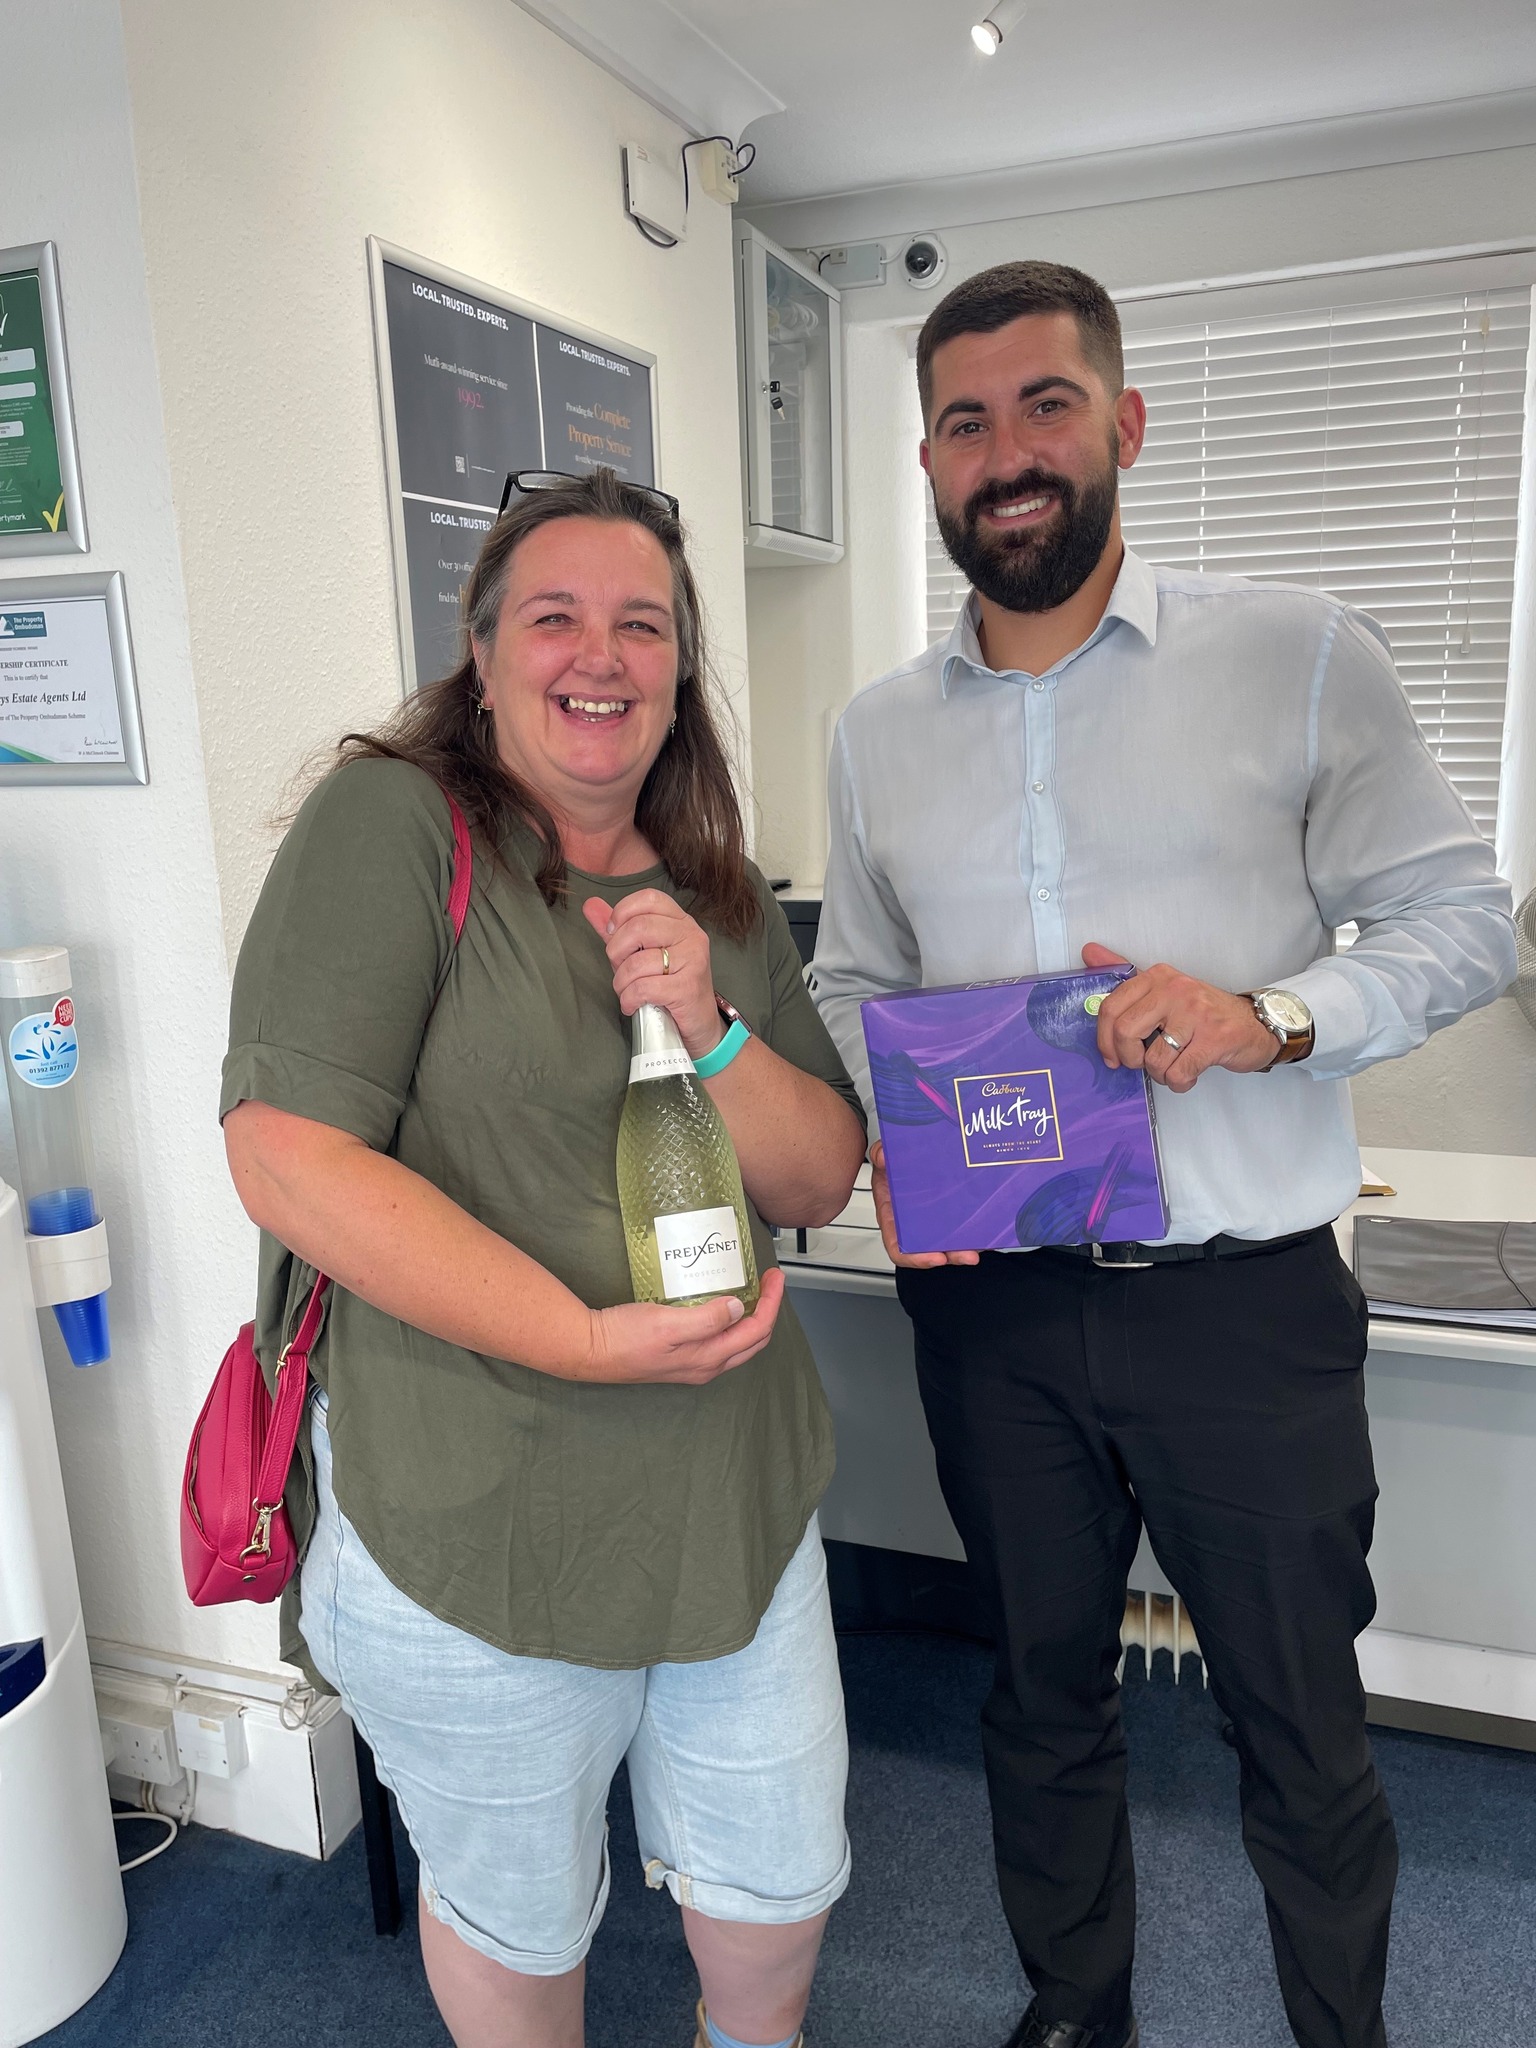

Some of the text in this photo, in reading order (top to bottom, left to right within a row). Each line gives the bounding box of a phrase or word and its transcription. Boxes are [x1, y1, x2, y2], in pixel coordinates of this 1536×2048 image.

[412, 283, 509, 330] LOCAL. TRUSTED. EXPERTS.
[560, 341, 631, 376] LOCAL. TRUSTED. EXPERTS.
[458, 387, 484, 410] 1992.
[594, 402, 632, 431] Complete
[568, 424, 632, 458] Property Service
[430, 512, 459, 526] LOCAL.
[438, 559, 452, 570] Over
[438, 592, 450, 602] find
[450, 592, 460, 604] the
[25, 660, 68, 668] CERTIFICATE
[12, 693, 38, 703] Estate
[40, 692, 69, 705] Agents
[72, 691, 86, 701] Ltd
[645, 1058, 687, 1068] PROSECCO
[982, 1082, 1026, 1097] Cadbury
[965, 1096, 1054, 1136] Milk Tray
[664, 1232, 737, 1268] FREIXENET
[684, 1268, 727, 1278] PROSECCO
